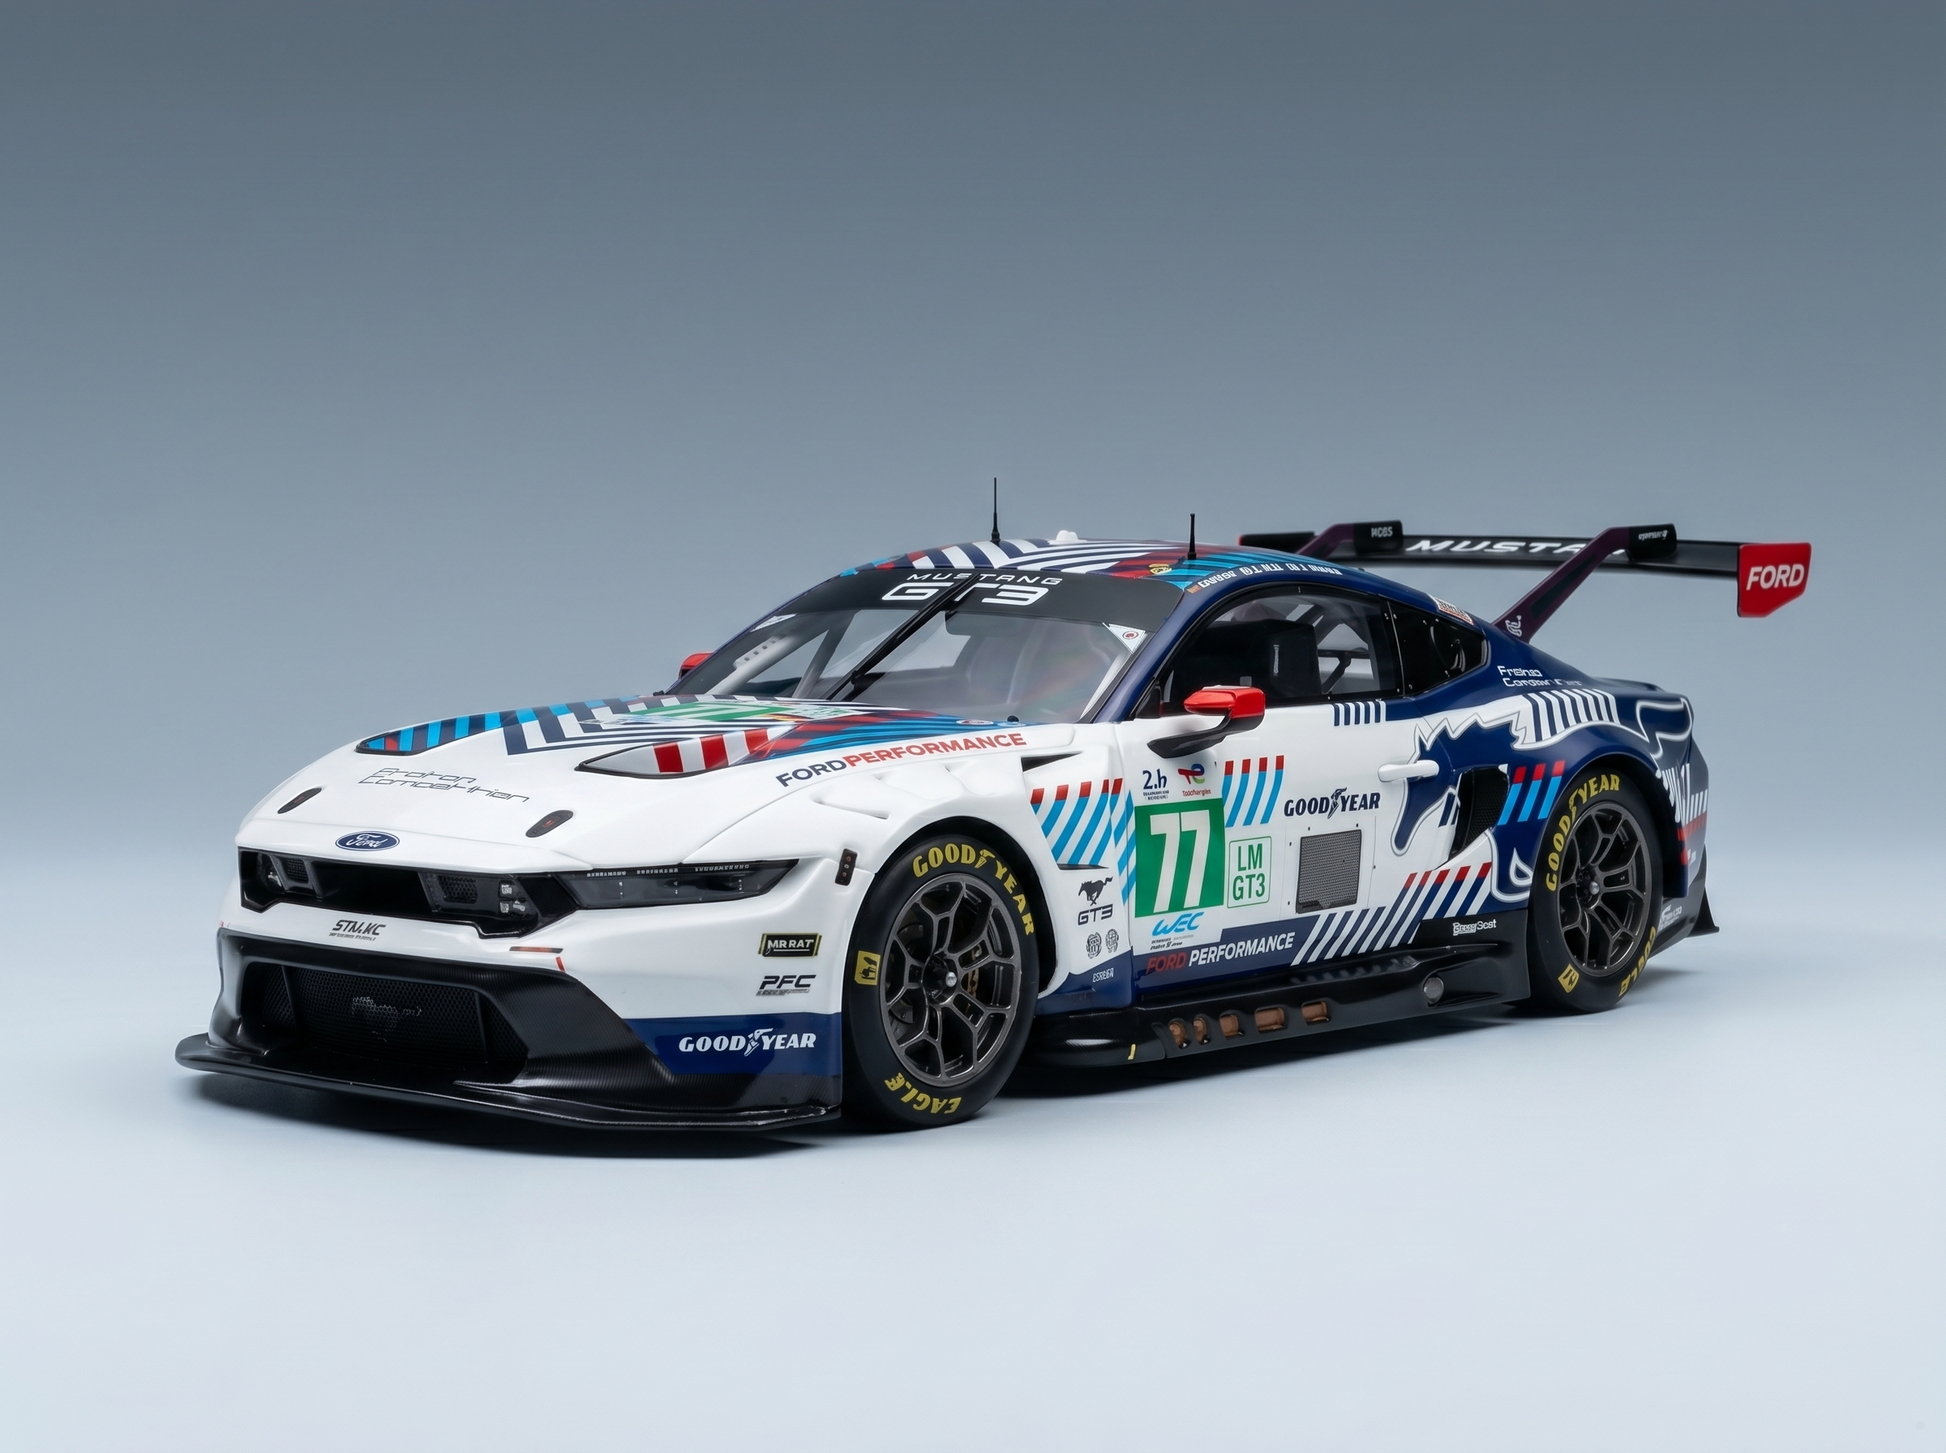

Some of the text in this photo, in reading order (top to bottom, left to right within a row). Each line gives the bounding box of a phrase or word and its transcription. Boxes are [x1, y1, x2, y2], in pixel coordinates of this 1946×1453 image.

[907, 573, 1063, 586] MUSTANG
[1746, 564, 1805, 591] FORD
[881, 582, 1049, 606] GT3
[1150, 810, 1210, 913] 77
[1237, 843, 1263, 872] LM
[1232, 873, 1266, 901] GT3
[1077, 903, 1113, 926] GT3
[1151, 911, 1205, 937] WEC
[1146, 932, 1296, 975] FORD PERFORMANCE
[759, 974, 817, 990] PFC
[884, 1072, 962, 1115] EAGLE
